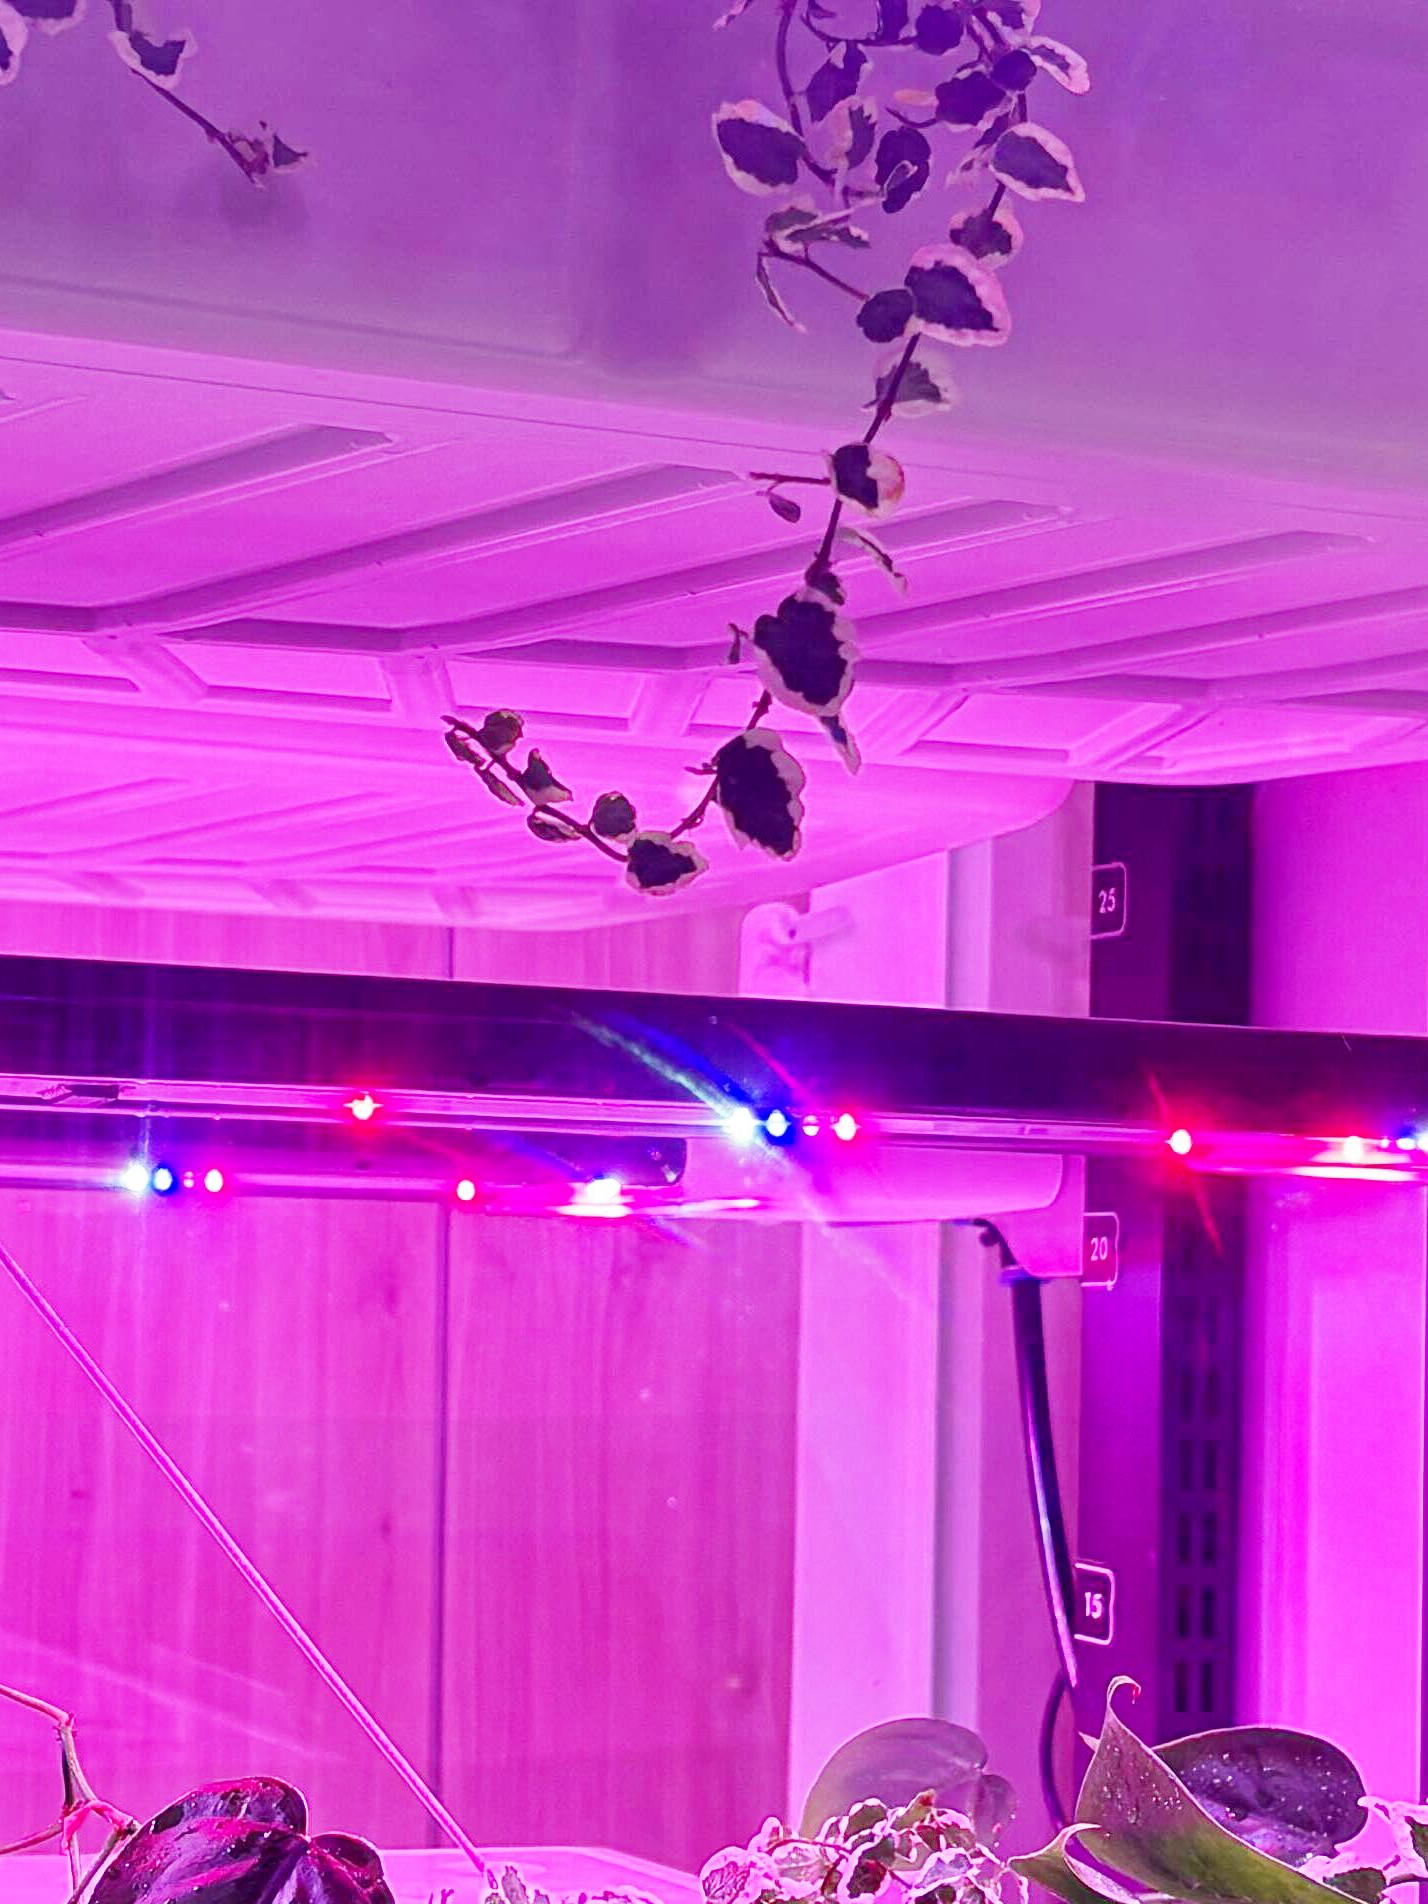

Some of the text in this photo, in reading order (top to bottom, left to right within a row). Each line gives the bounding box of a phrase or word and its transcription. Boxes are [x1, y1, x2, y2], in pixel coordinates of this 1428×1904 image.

[1098, 887, 1118, 914] 25
[1089, 1236, 1109, 1262] 20
[1083, 1591, 1104, 1620] 15
